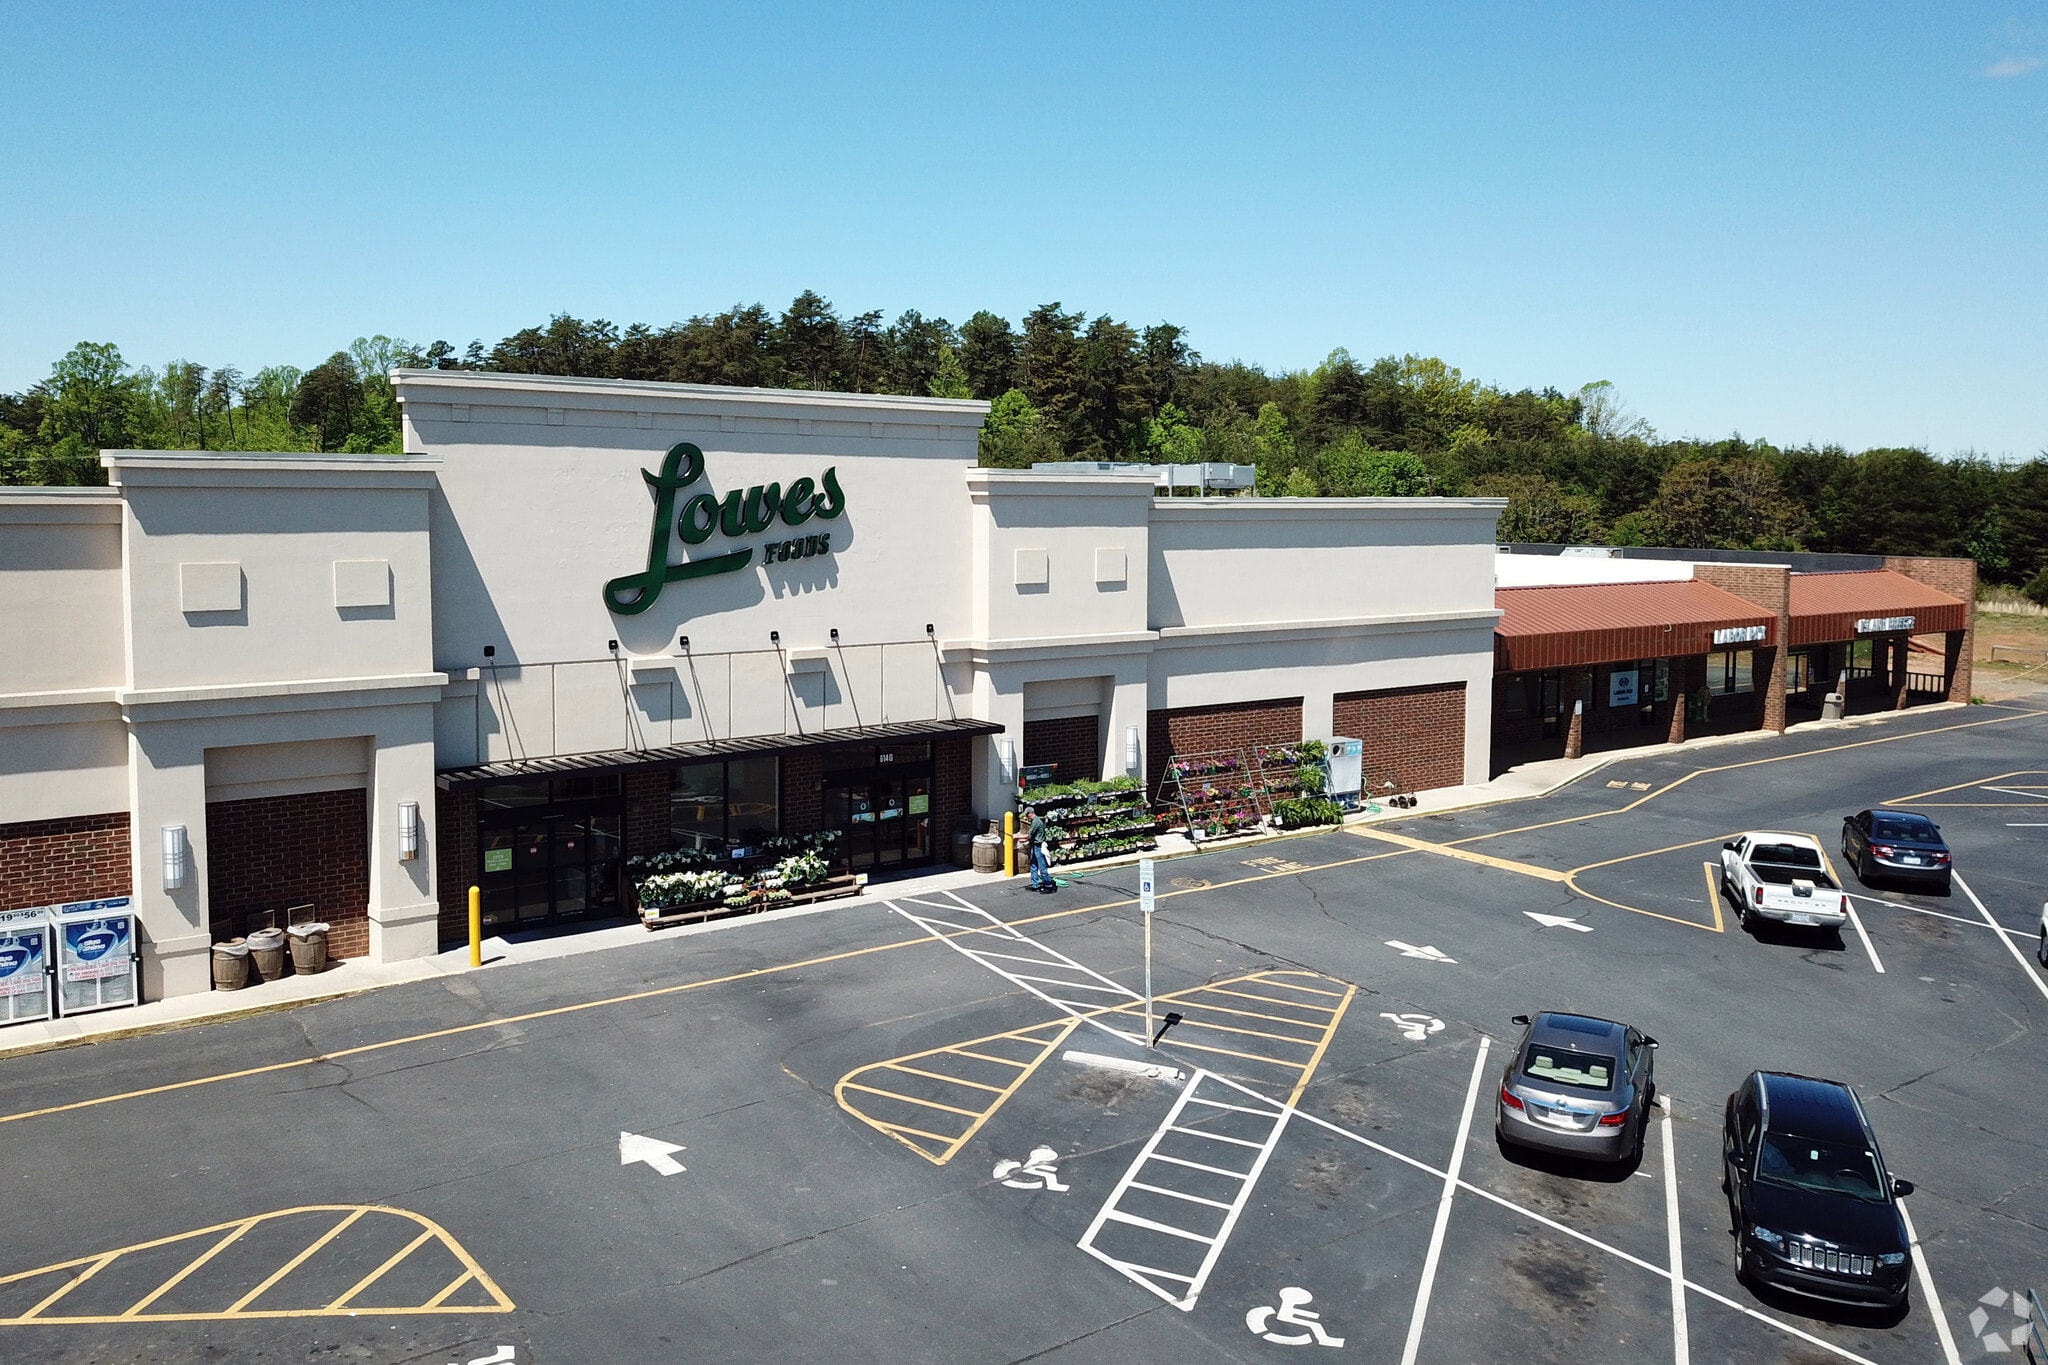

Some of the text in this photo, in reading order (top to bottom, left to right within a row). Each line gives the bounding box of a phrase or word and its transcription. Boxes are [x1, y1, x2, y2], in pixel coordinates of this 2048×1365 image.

[602, 442, 846, 616] Lowes
[762, 533, 831, 565] FOODS
[1858, 618, 1886, 633] ISLAND
[1714, 627, 1746, 645] LABOR
[1239, 856, 1287, 867] FIRE
[1259, 861, 1310, 874] LANE
[1777, 899, 1827, 908] FRONTIER
